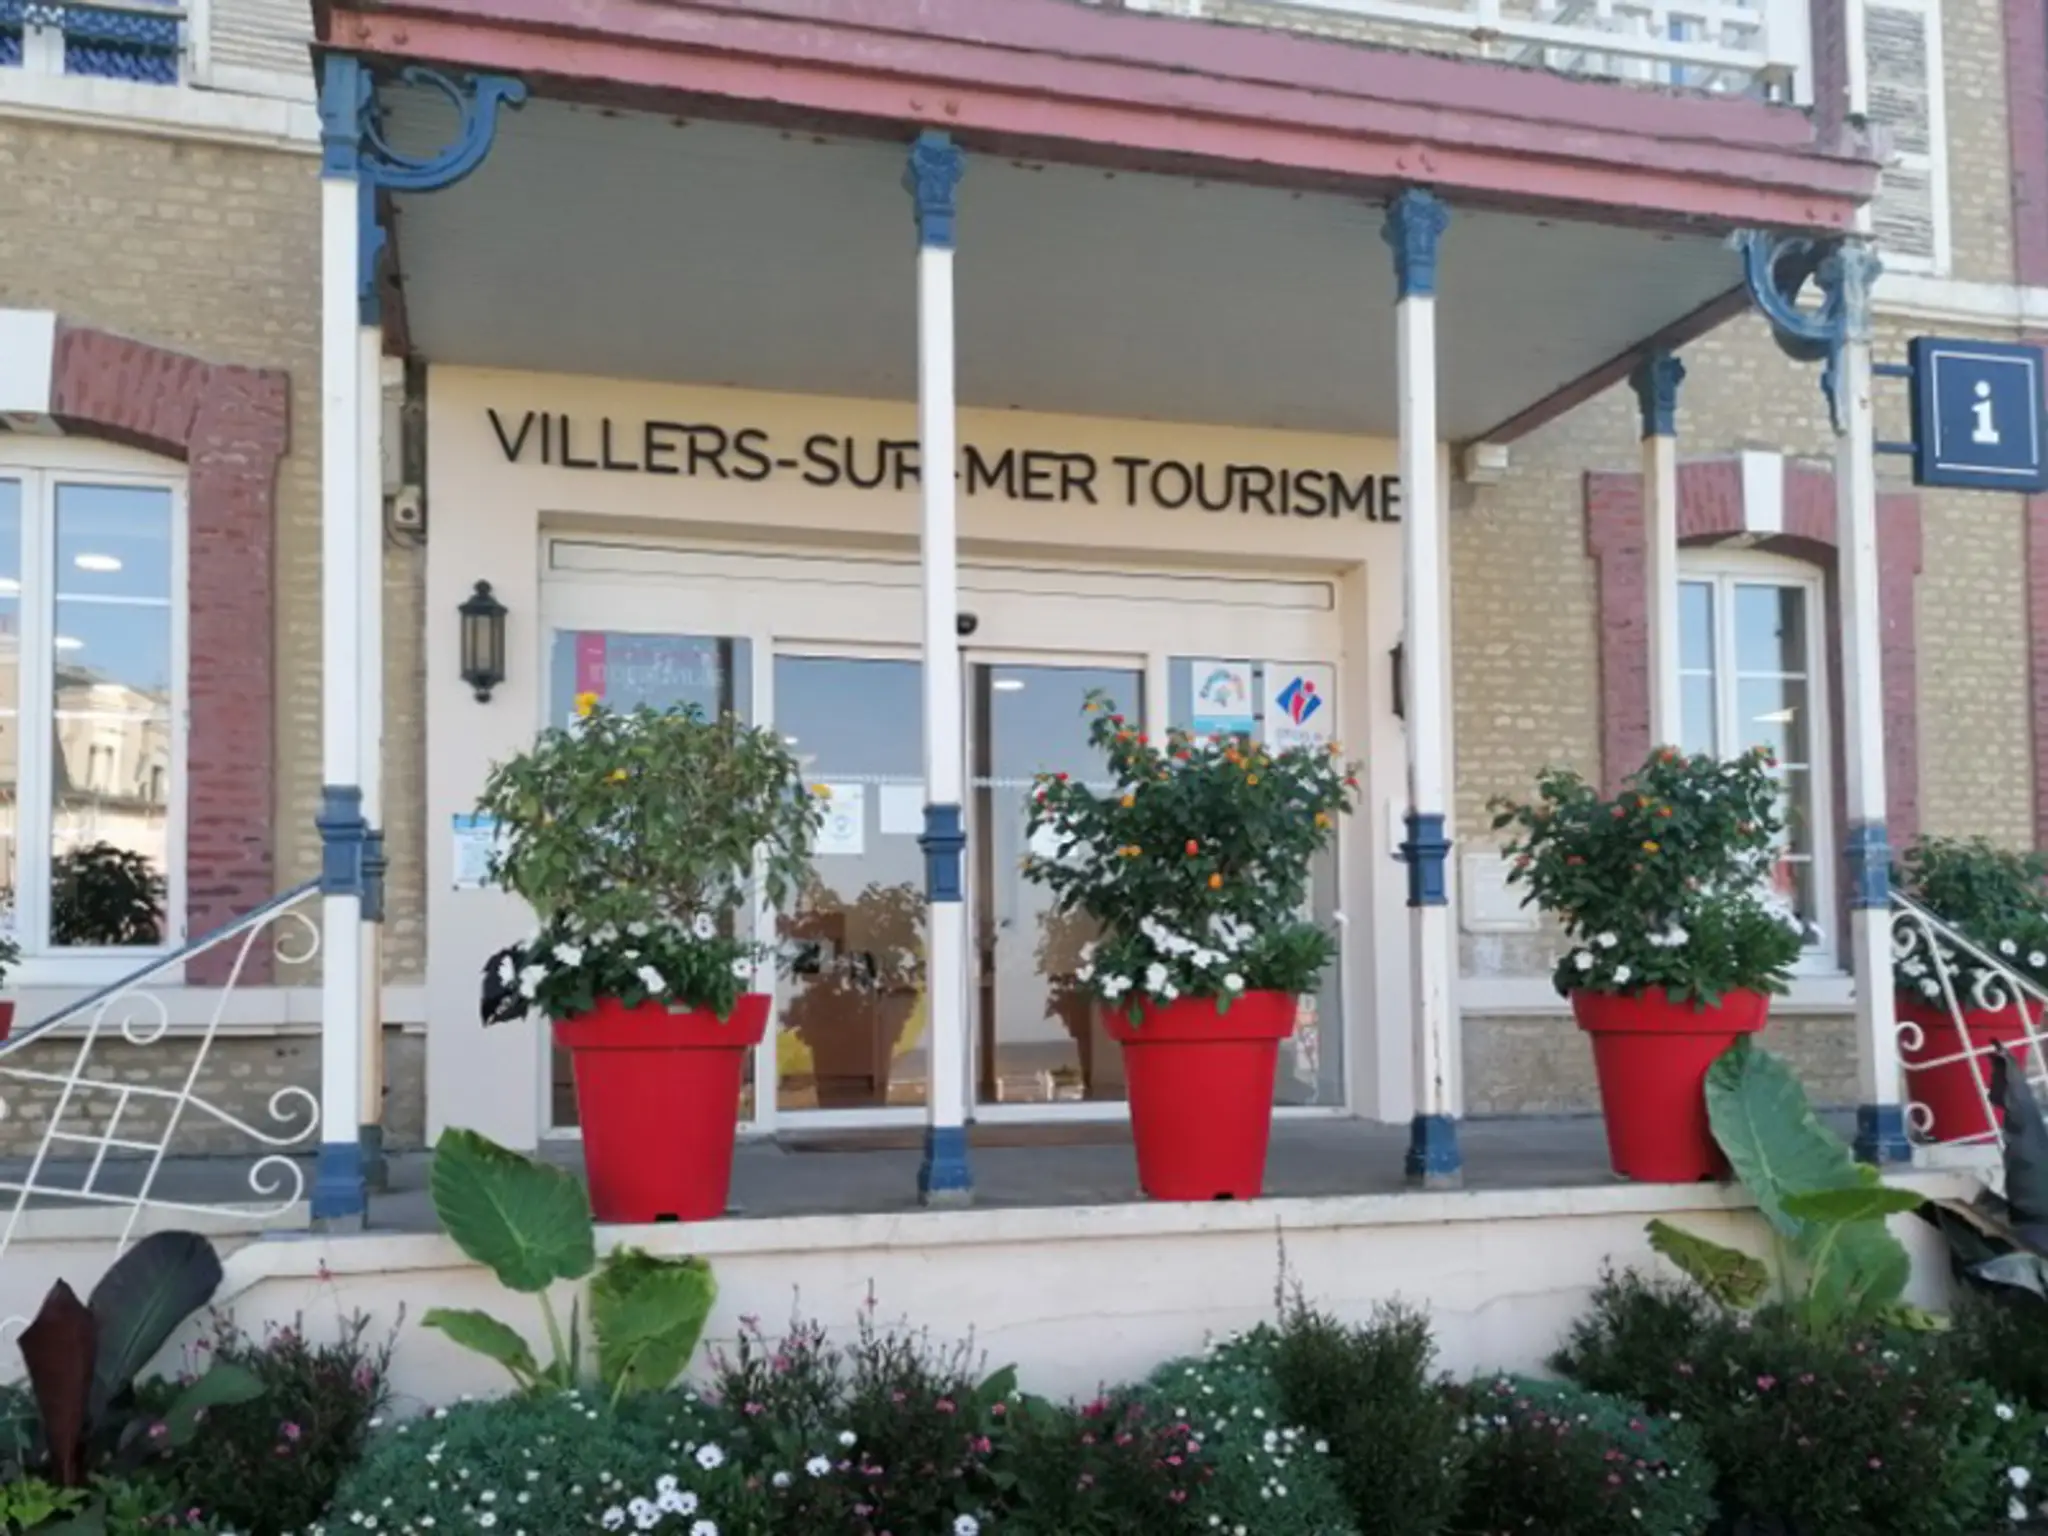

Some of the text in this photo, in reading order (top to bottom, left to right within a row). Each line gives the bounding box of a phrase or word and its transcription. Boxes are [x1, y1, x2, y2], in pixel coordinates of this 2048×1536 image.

[1971, 380, 2000, 444] i
[486, 407, 1401, 523] VILLERS-SURMER TOURISME
